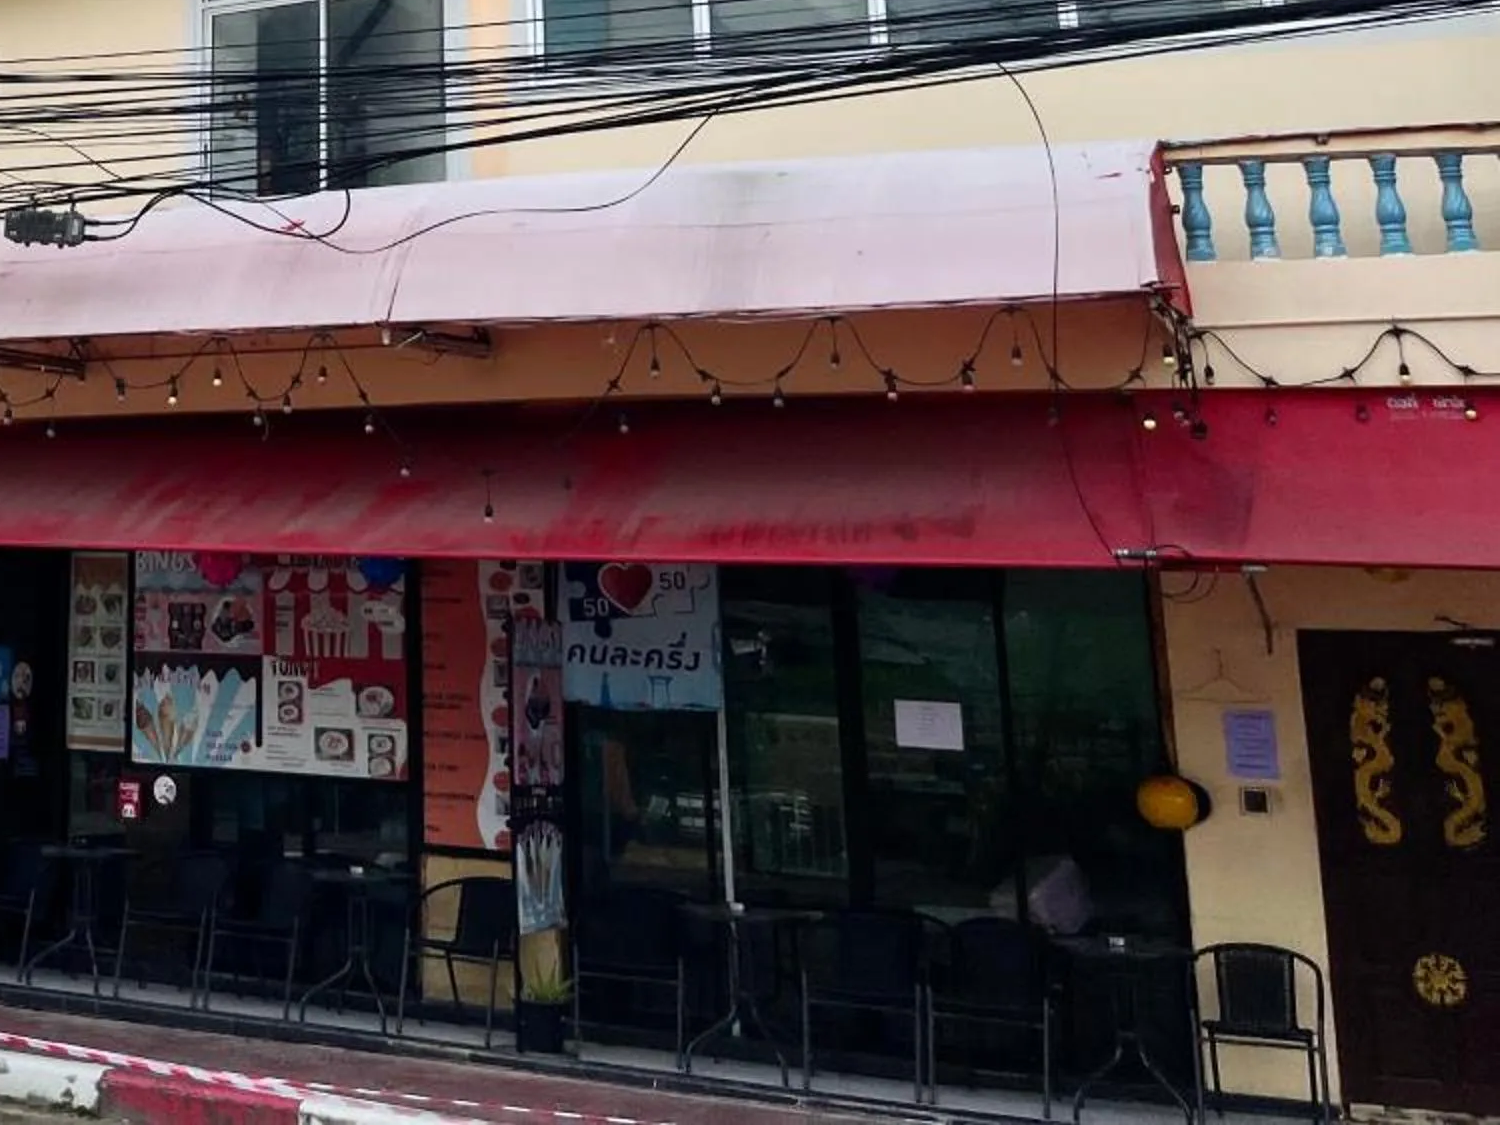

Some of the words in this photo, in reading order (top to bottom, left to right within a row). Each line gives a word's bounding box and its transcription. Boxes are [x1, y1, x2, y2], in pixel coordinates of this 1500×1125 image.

[136, 551, 197, 573] BINGS
[660, 571, 686, 590] 50
[583, 598, 609, 617] 50
[567, 631, 700, 671] คนละครึ่ง
